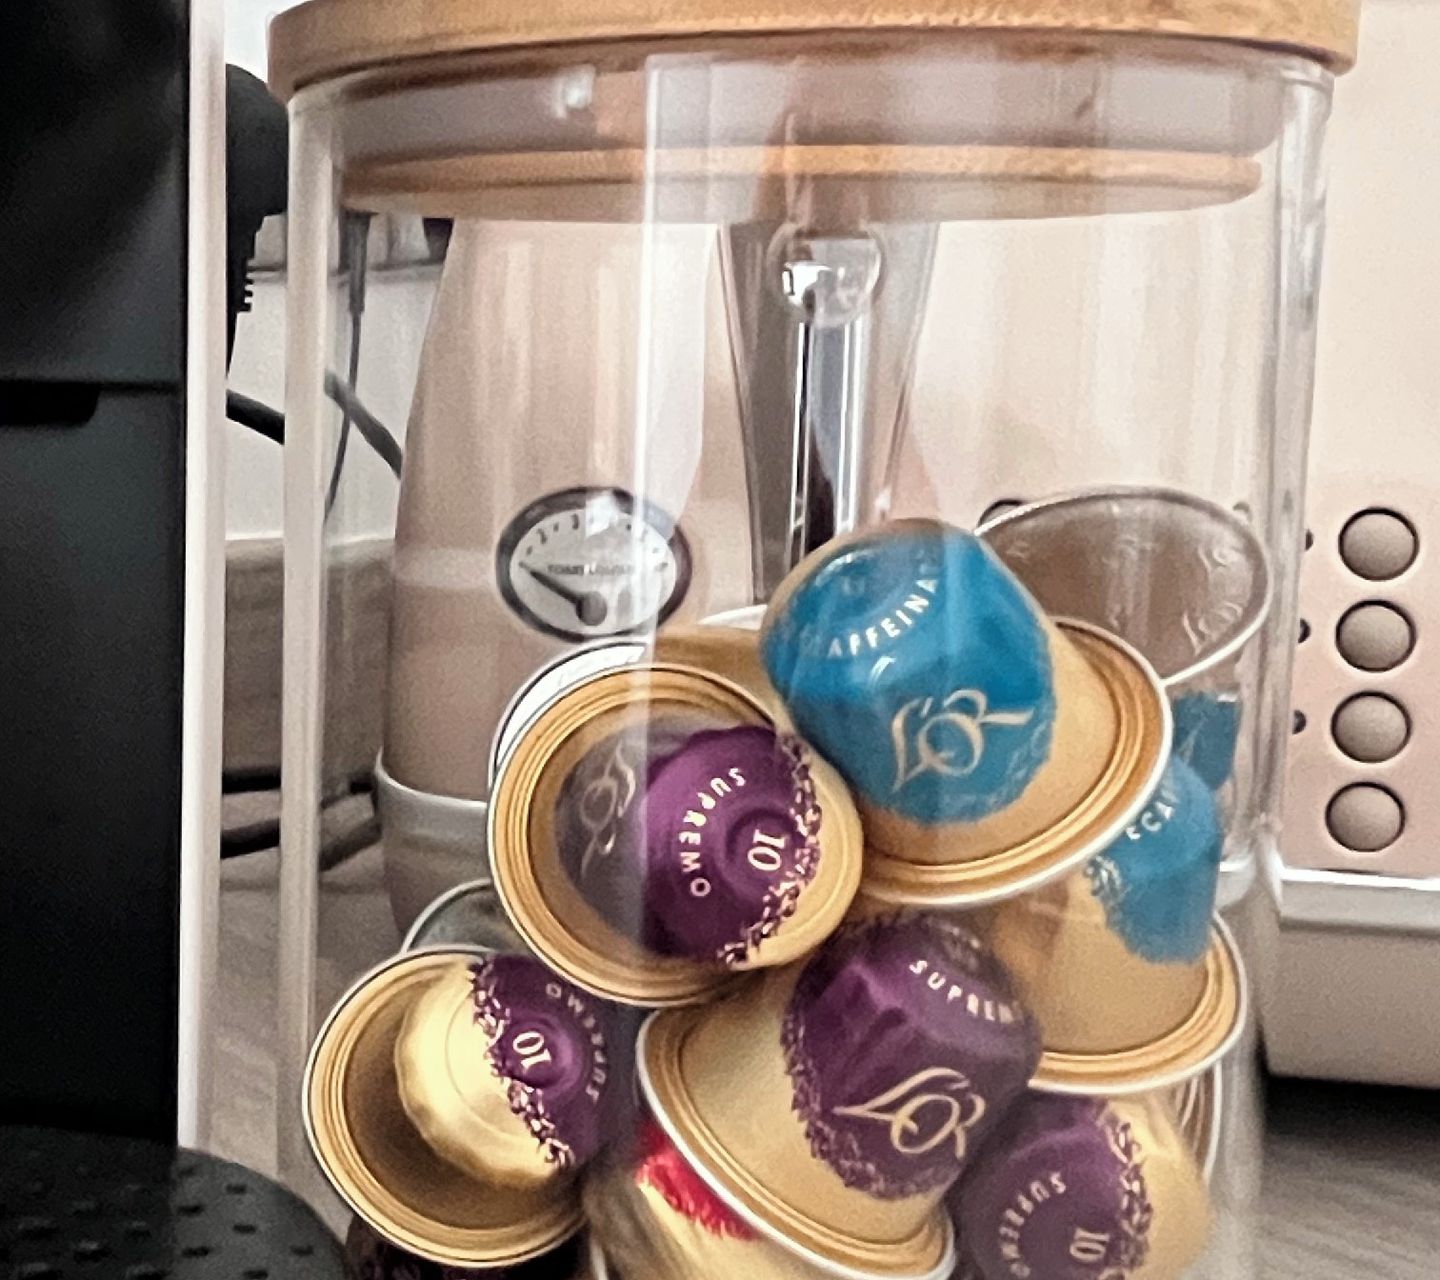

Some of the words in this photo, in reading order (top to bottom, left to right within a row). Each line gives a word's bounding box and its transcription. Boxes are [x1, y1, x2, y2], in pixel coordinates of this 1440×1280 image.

[678, 767, 746, 897] SUPREMO
[747, 829, 785, 872] 10
[512, 1030, 552, 1072] 10
[1069, 1227, 1110, 1263] 10
